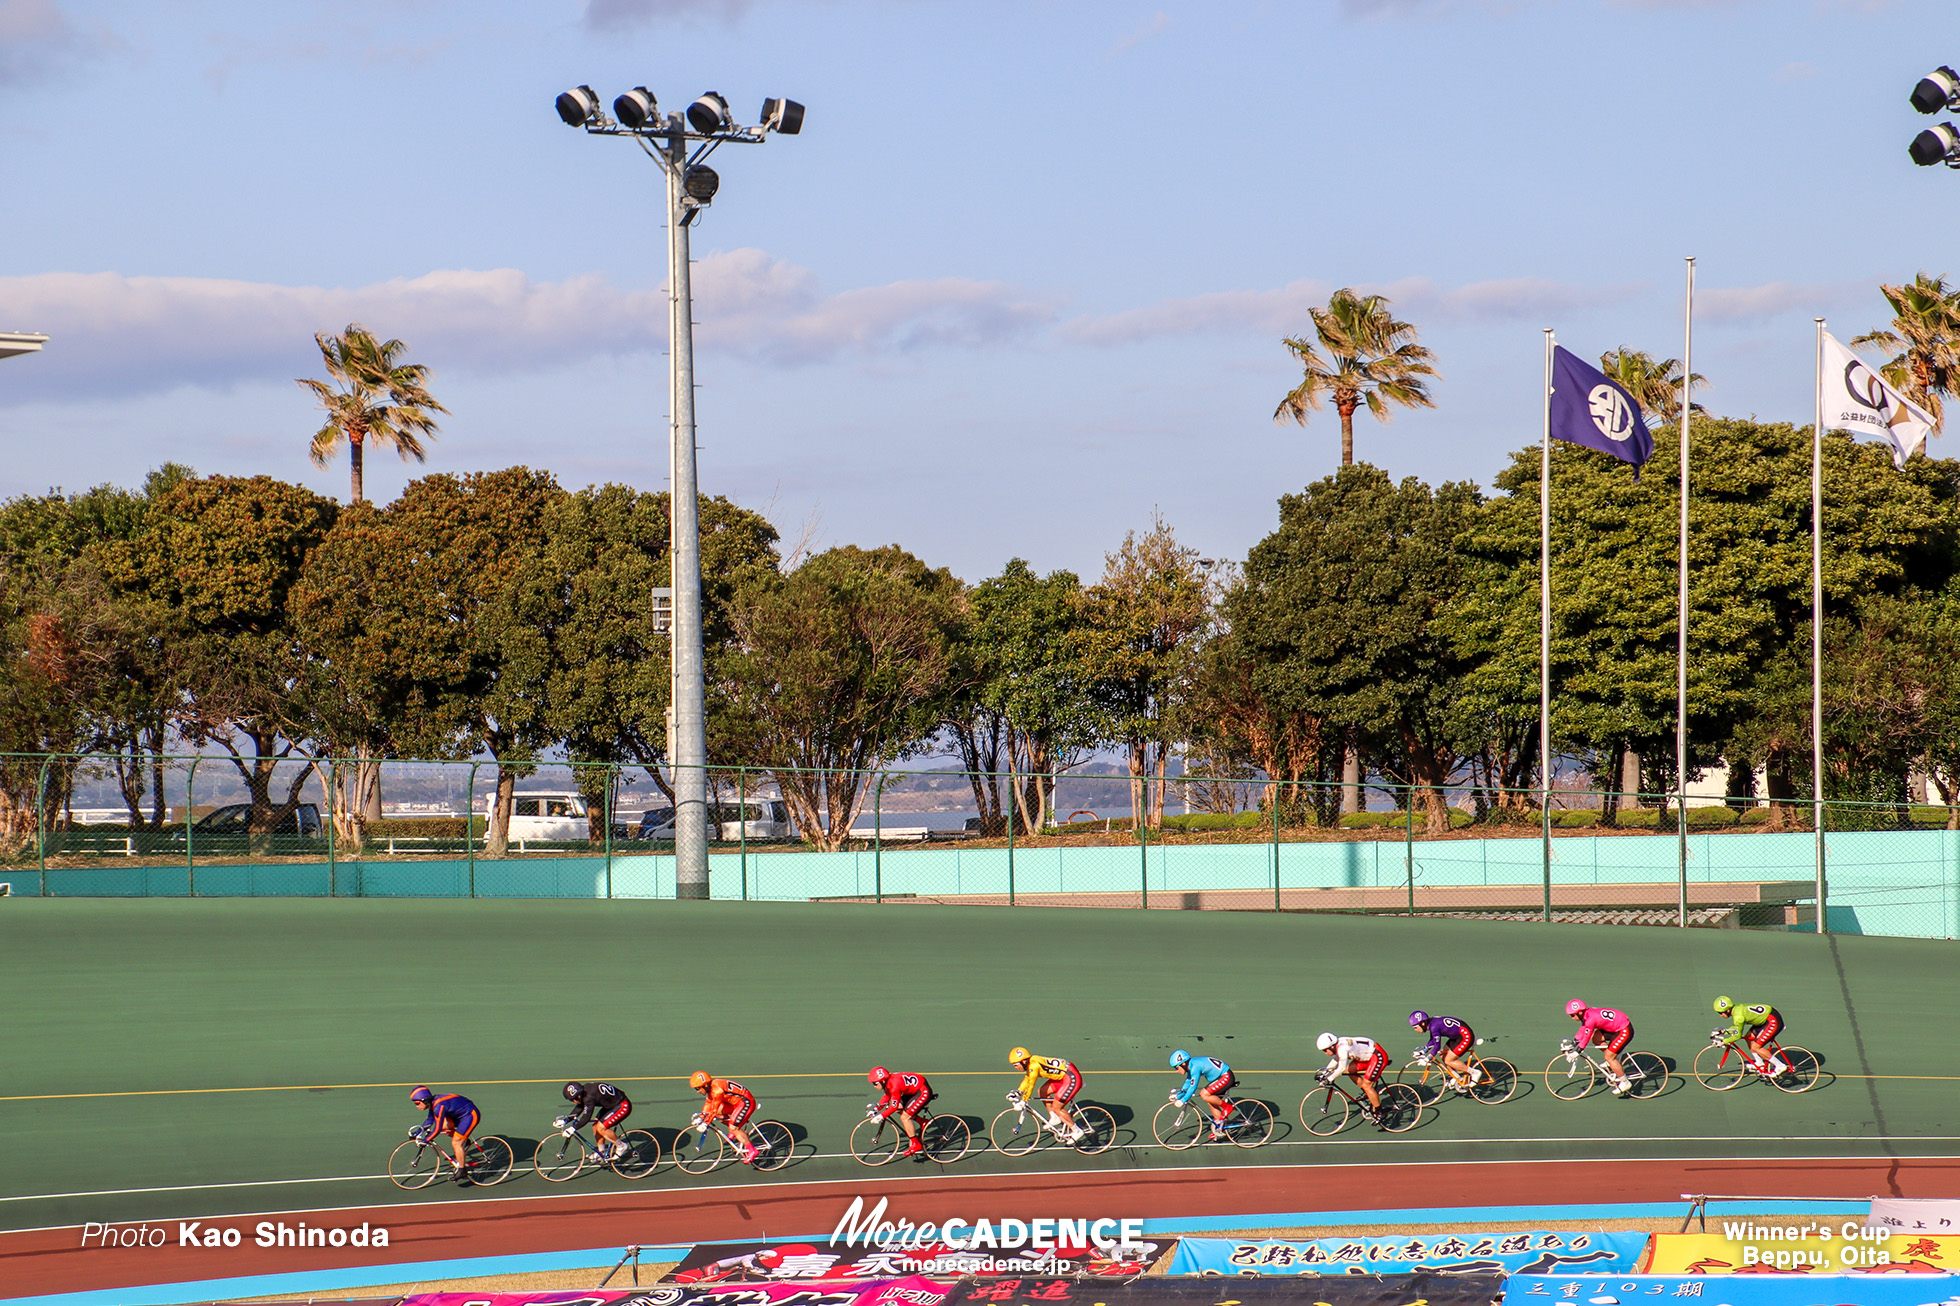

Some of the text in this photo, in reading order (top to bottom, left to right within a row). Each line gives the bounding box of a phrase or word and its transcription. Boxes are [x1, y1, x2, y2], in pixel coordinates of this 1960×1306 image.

[1600, 1009, 1616, 1021] 8
[1748, 1005, 1766, 1015] 6
[1415, 1012, 1422, 1021] 9
[1443, 1017, 1461, 1028] 9
[1015, 1048, 1024, 1058] 5
[1176, 1053, 1184, 1062] 4
[1046, 1058, 1061, 1068] 5
[1208, 1056, 1224, 1070] 4
[697, 1073, 706, 1083] 7
[902, 1074, 919, 1087] 3
[567, 1084, 578, 1097] 2
[598, 1083, 616, 1096] 2
[727, 1080, 744, 1092] 7
